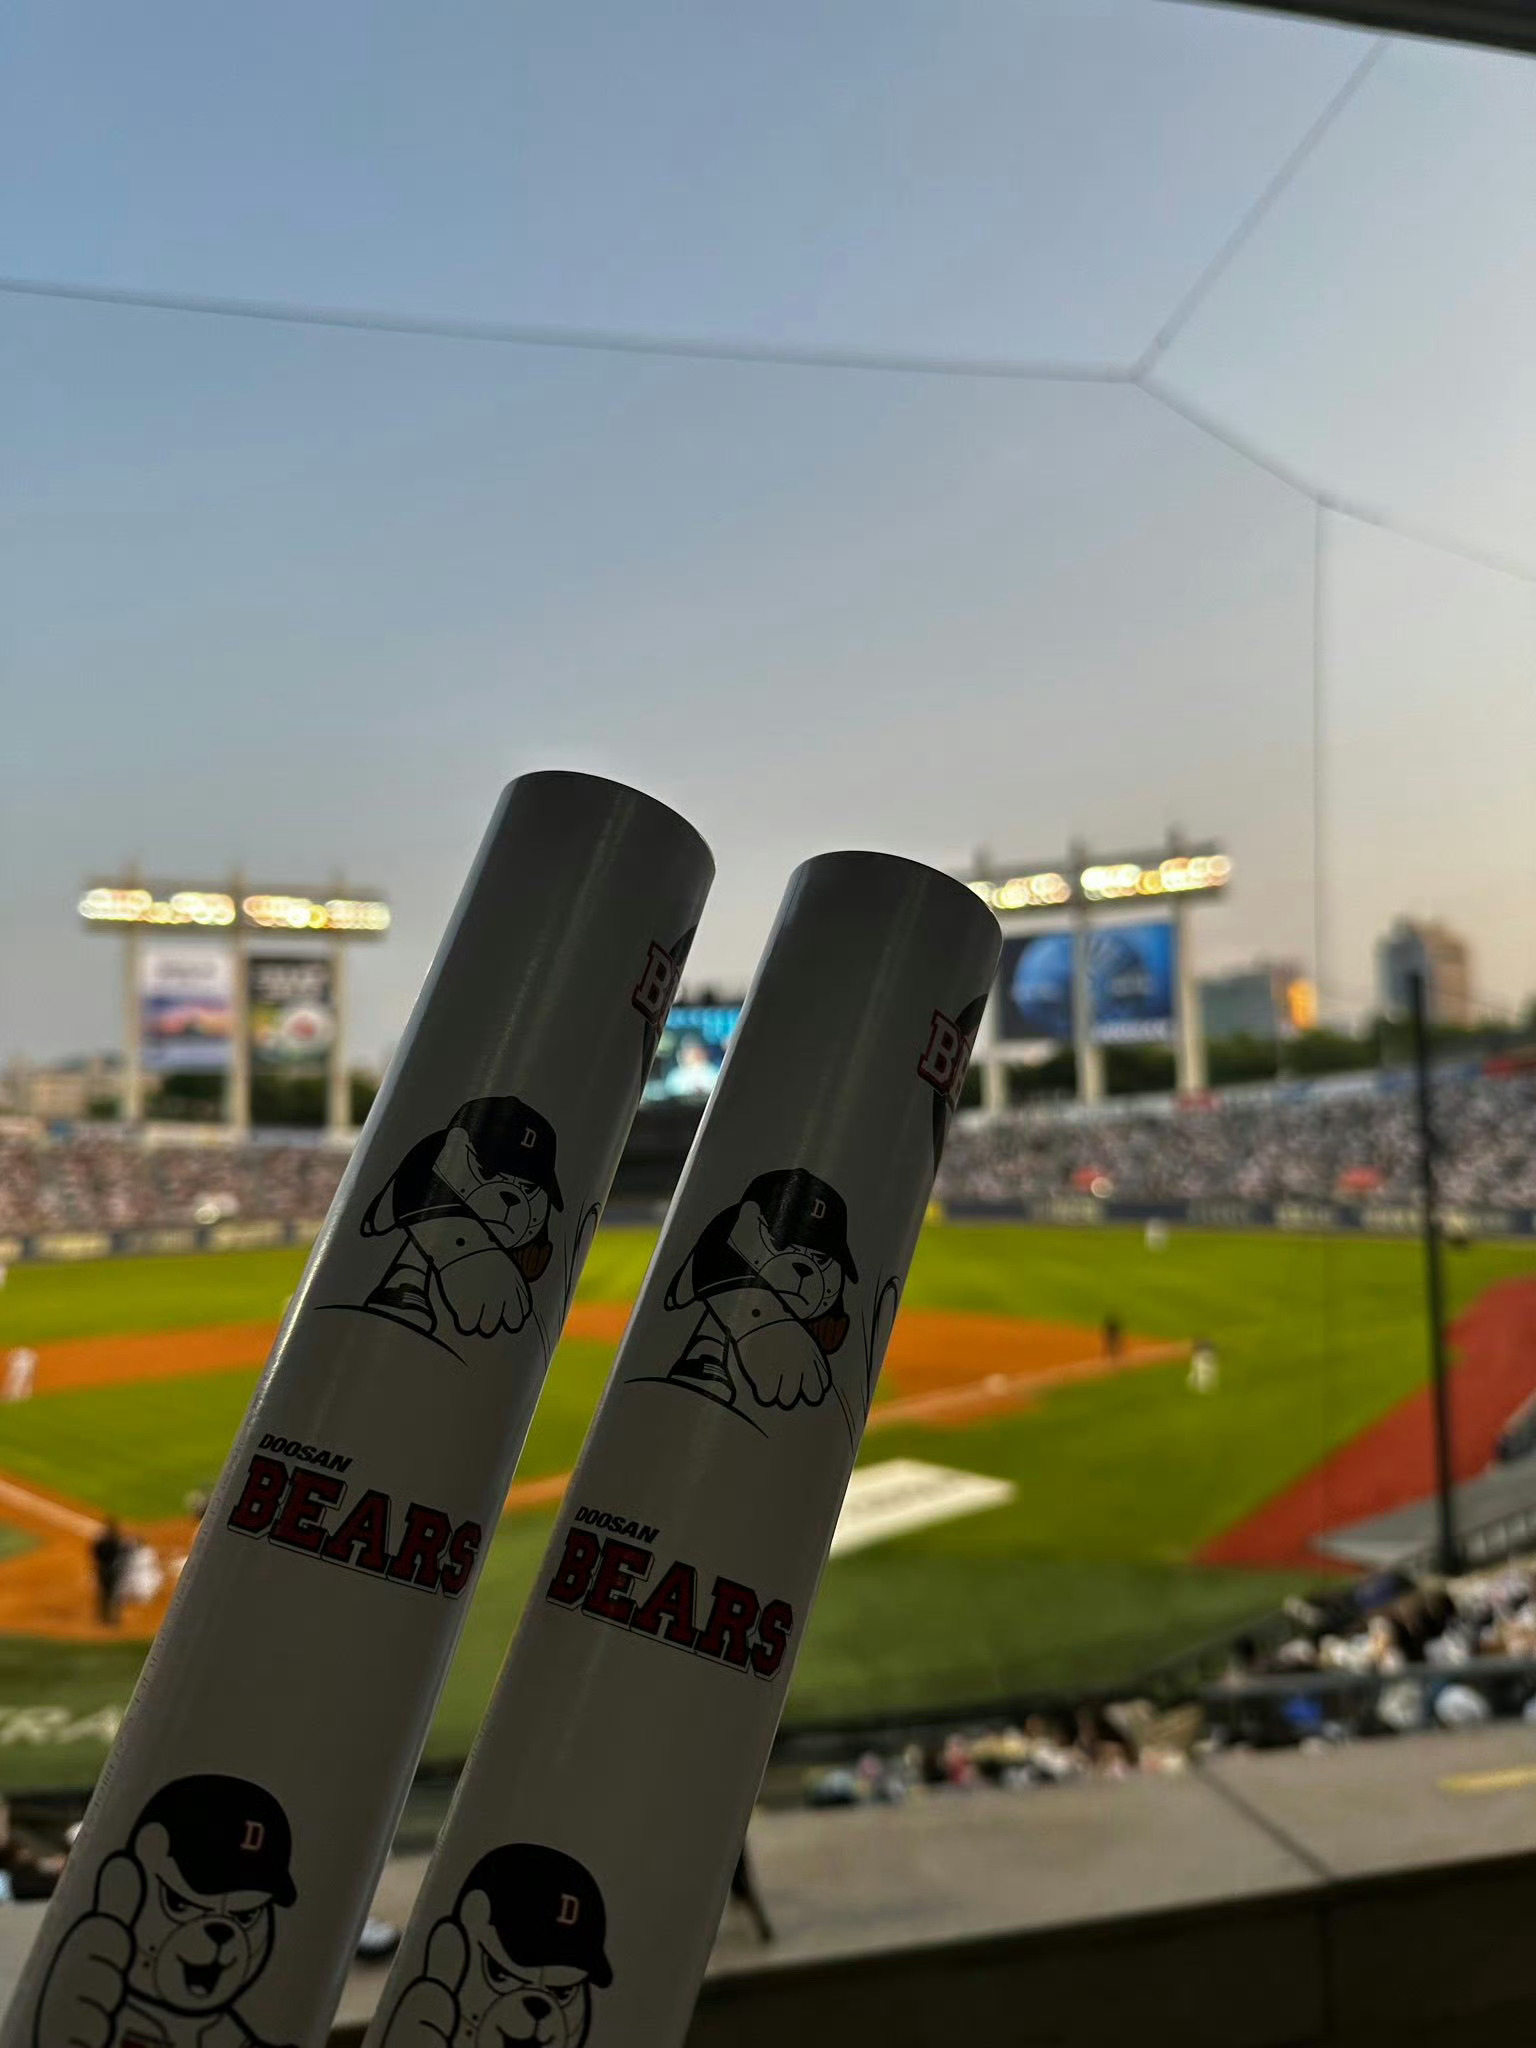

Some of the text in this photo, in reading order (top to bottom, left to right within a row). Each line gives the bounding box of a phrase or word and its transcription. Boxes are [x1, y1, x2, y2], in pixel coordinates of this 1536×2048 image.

[520, 1127, 538, 1149] D
[810, 1199, 828, 1220] D
[258, 1433, 353, 1473] DOOSAN
[227, 1454, 482, 1600] BEARS
[574, 1506, 660, 1544] DOOSAN
[545, 1527, 794, 1682] BEARS
[240, 1820, 264, 1851] D
[556, 1895, 580, 1926] D
